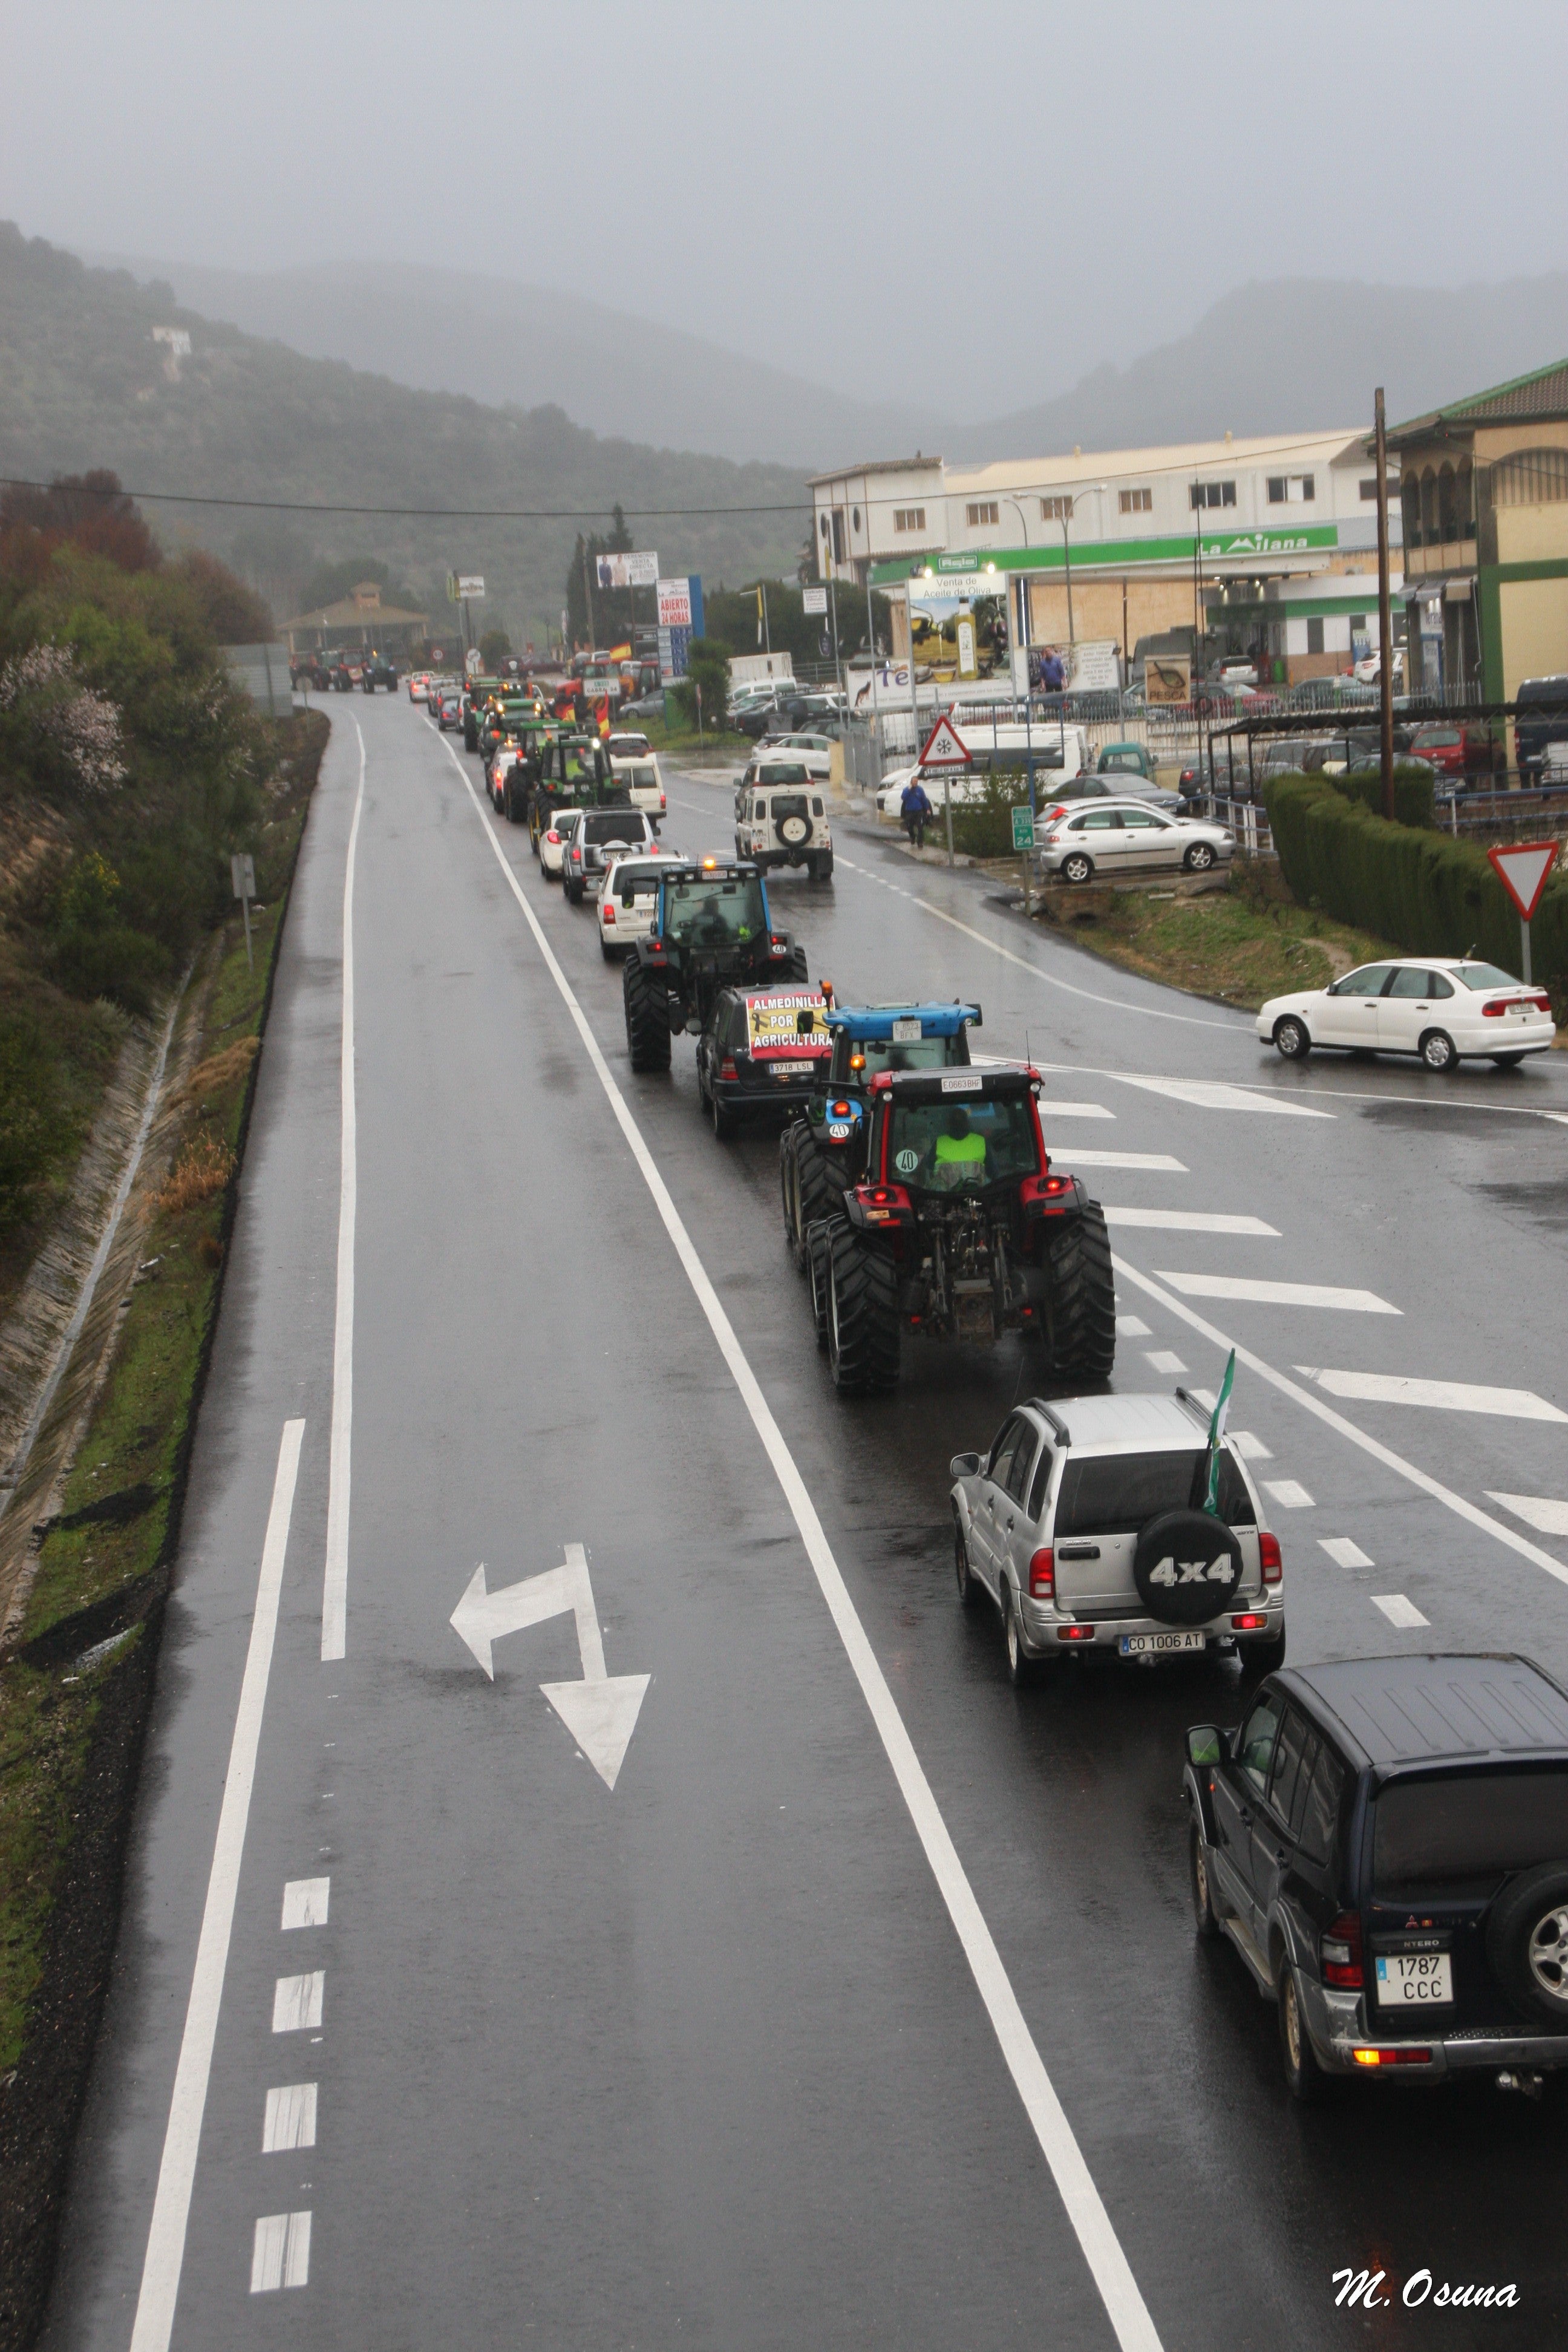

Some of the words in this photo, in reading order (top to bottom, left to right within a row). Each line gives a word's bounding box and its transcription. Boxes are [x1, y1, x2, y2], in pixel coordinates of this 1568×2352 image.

[1198, 543, 1221, 555] La
[1226, 533, 1308, 552] Milana
[936, 578, 963, 587] Venta
[924, 589, 951, 598] Aceite
[954, 587, 965, 596] de
[968, 586, 991, 595] Oliva
[661, 598, 688, 611] ABIERTO
[662, 612, 668, 624] 24
[670, 612, 689, 624] HORAS
[1149, 691, 1186, 701] PESCA
[1017, 836, 1032, 846] 24
[775, 945, 784, 953] 40
[753, 996, 827, 1010] ALMEDINILLA
[770, 1014, 794, 1028] POR
[754, 1033, 833, 1048] AGRICULTURA
[775, 1063, 793, 1072] 3718
[797, 1062, 811, 1071] LSL
[832, 1124, 846, 1137] 40
[901, 1151, 914, 1171] 40
[1150, 1553, 1235, 1587] 4x4
[1129, 1637, 1145, 1650] CO
[1150, 1635, 1181, 1649] 1006
[1184, 1633, 1200, 1647] AT
[1398, 1956, 1440, 1976] 1787
[1403, 1980, 1442, 2000] CCC
